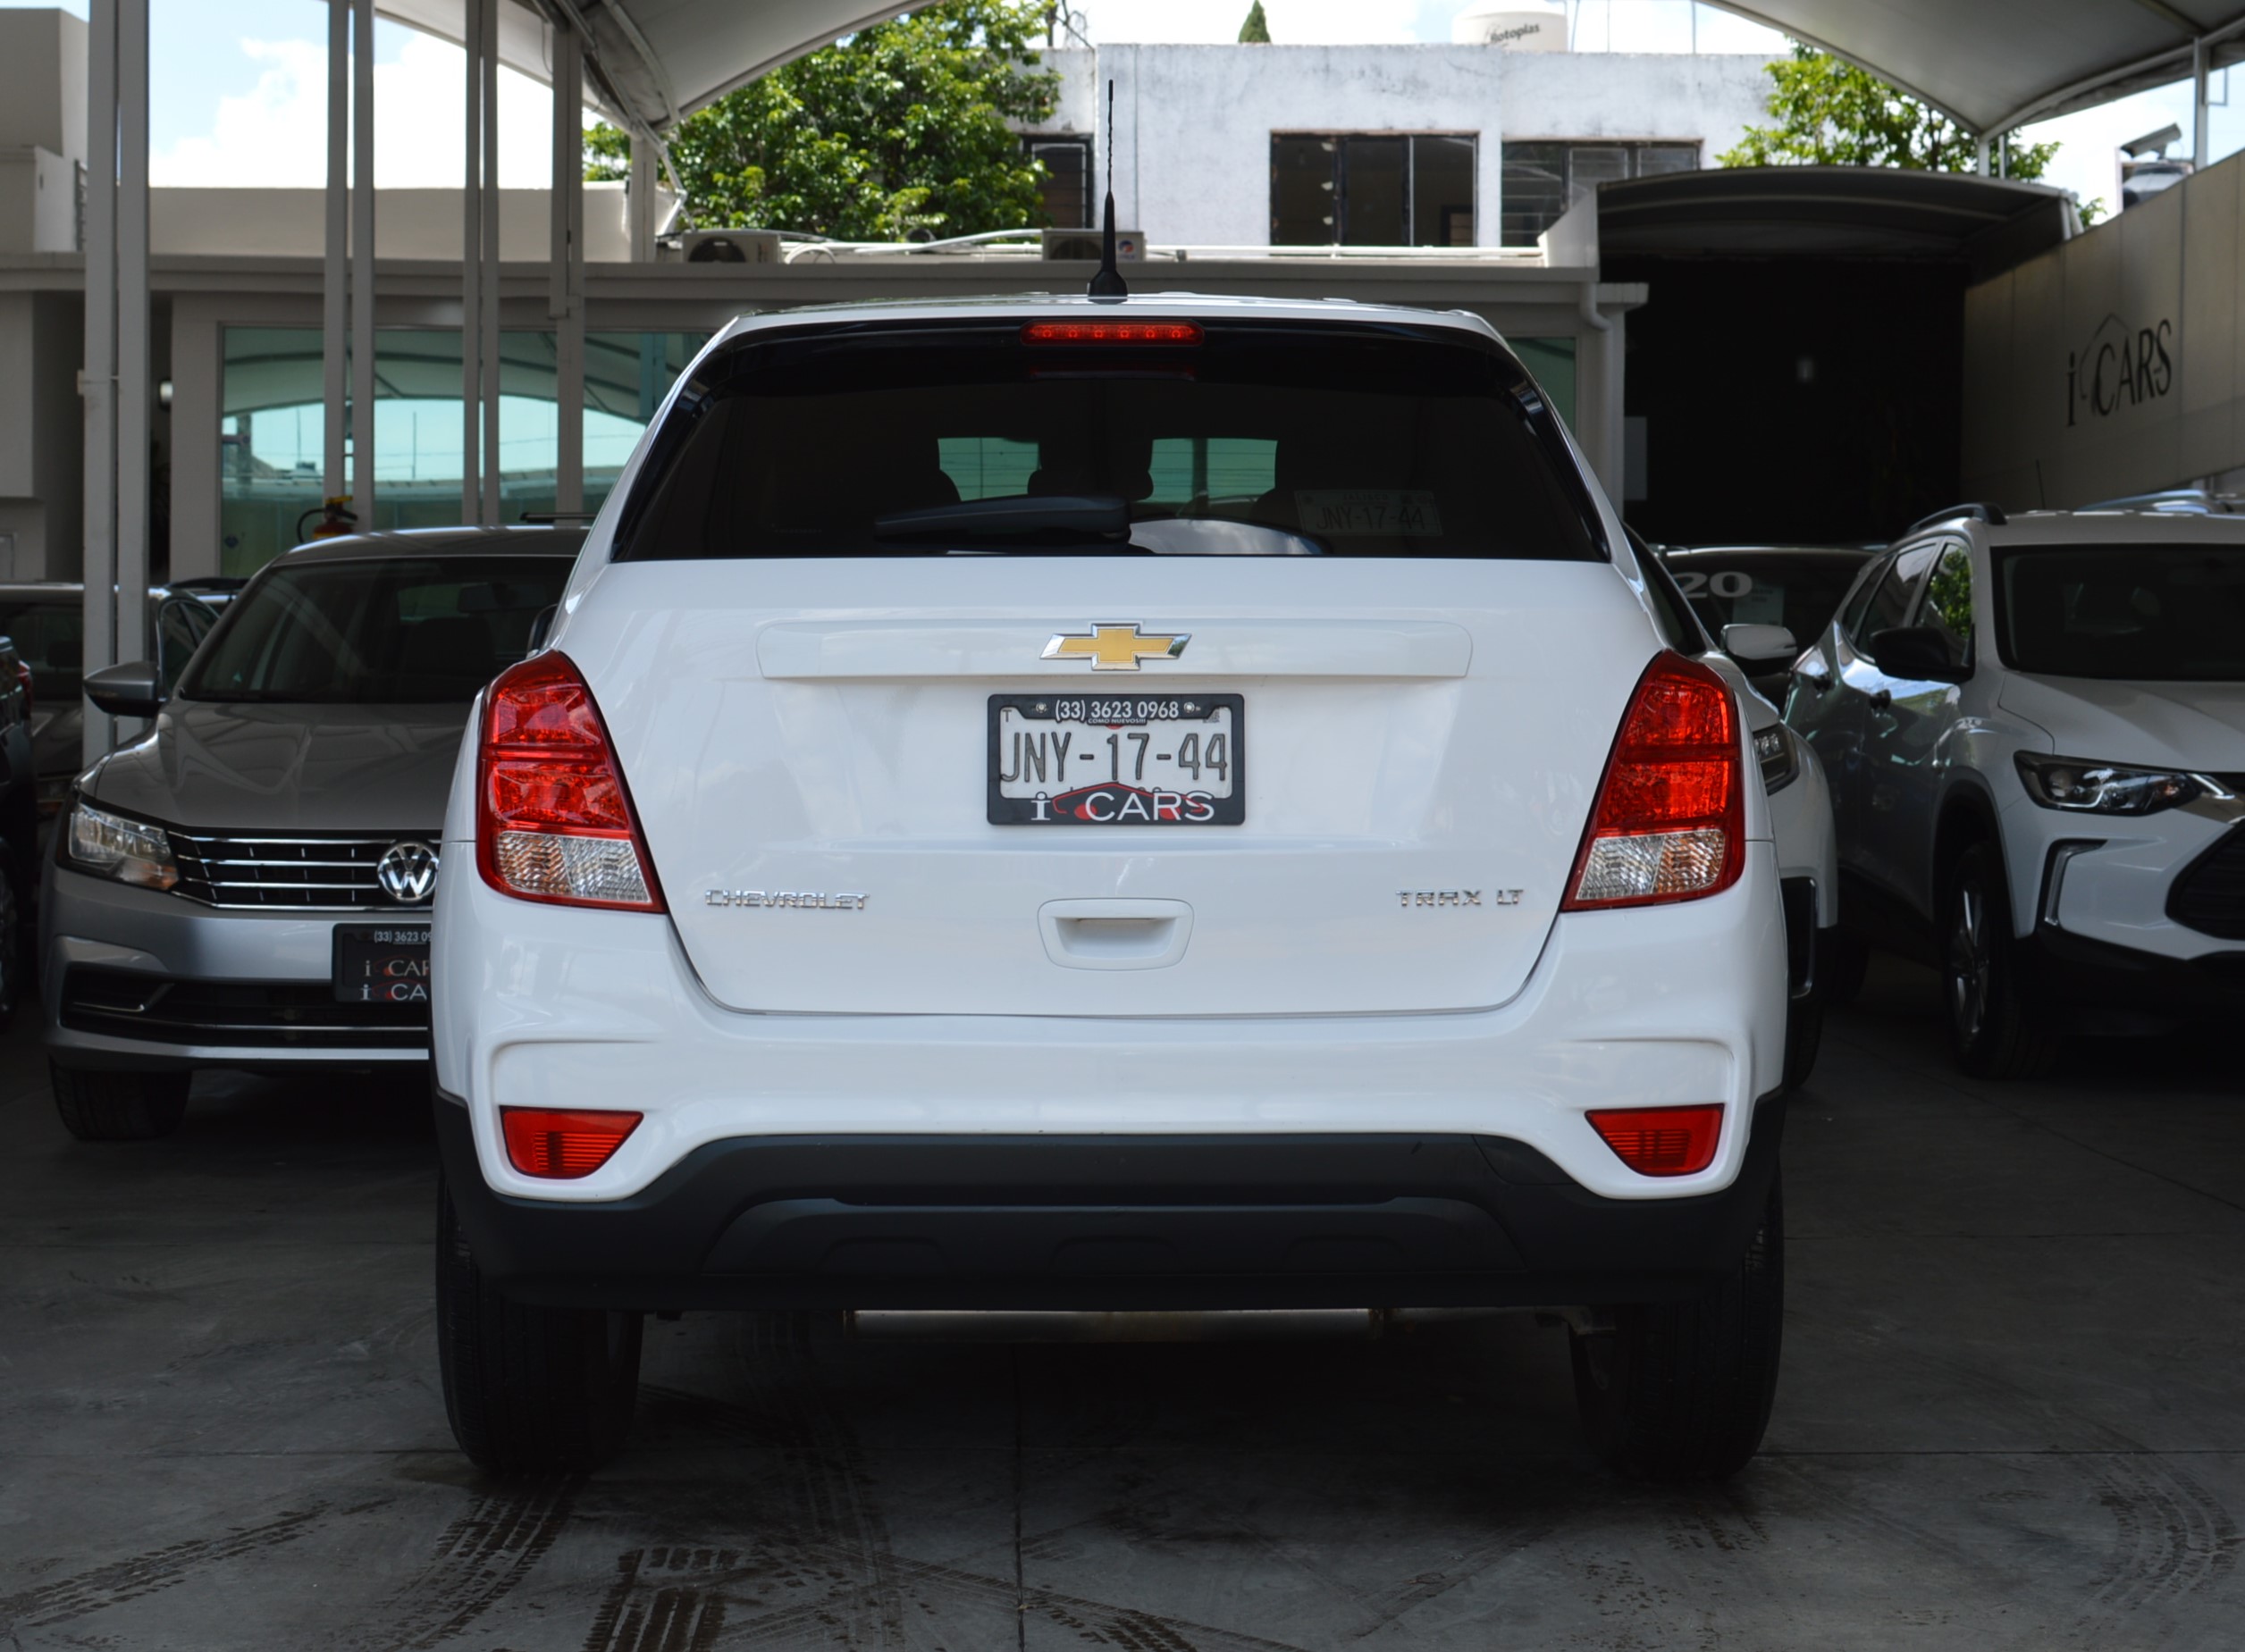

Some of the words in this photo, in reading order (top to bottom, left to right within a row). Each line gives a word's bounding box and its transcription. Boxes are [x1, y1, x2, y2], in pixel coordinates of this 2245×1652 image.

[2095, 318, 2172, 417] CARS
[1316, 506, 1425, 530] JNY-17-44
[1055, 700, 1086, 722] (33)
[1091, 701, 1132, 718] 3623
[1137, 701, 1180, 718] 0968
[1000, 731, 1228, 784] JNY-17-44
[1030, 792, 1051, 821] i
[1085, 791, 1215, 821] CARS
[705, 889, 870, 910] CHEVROLET
[1395, 889, 1482, 907] TRAX
[1497, 889, 1524, 905] LT
[394, 931, 418, 943] 3623
